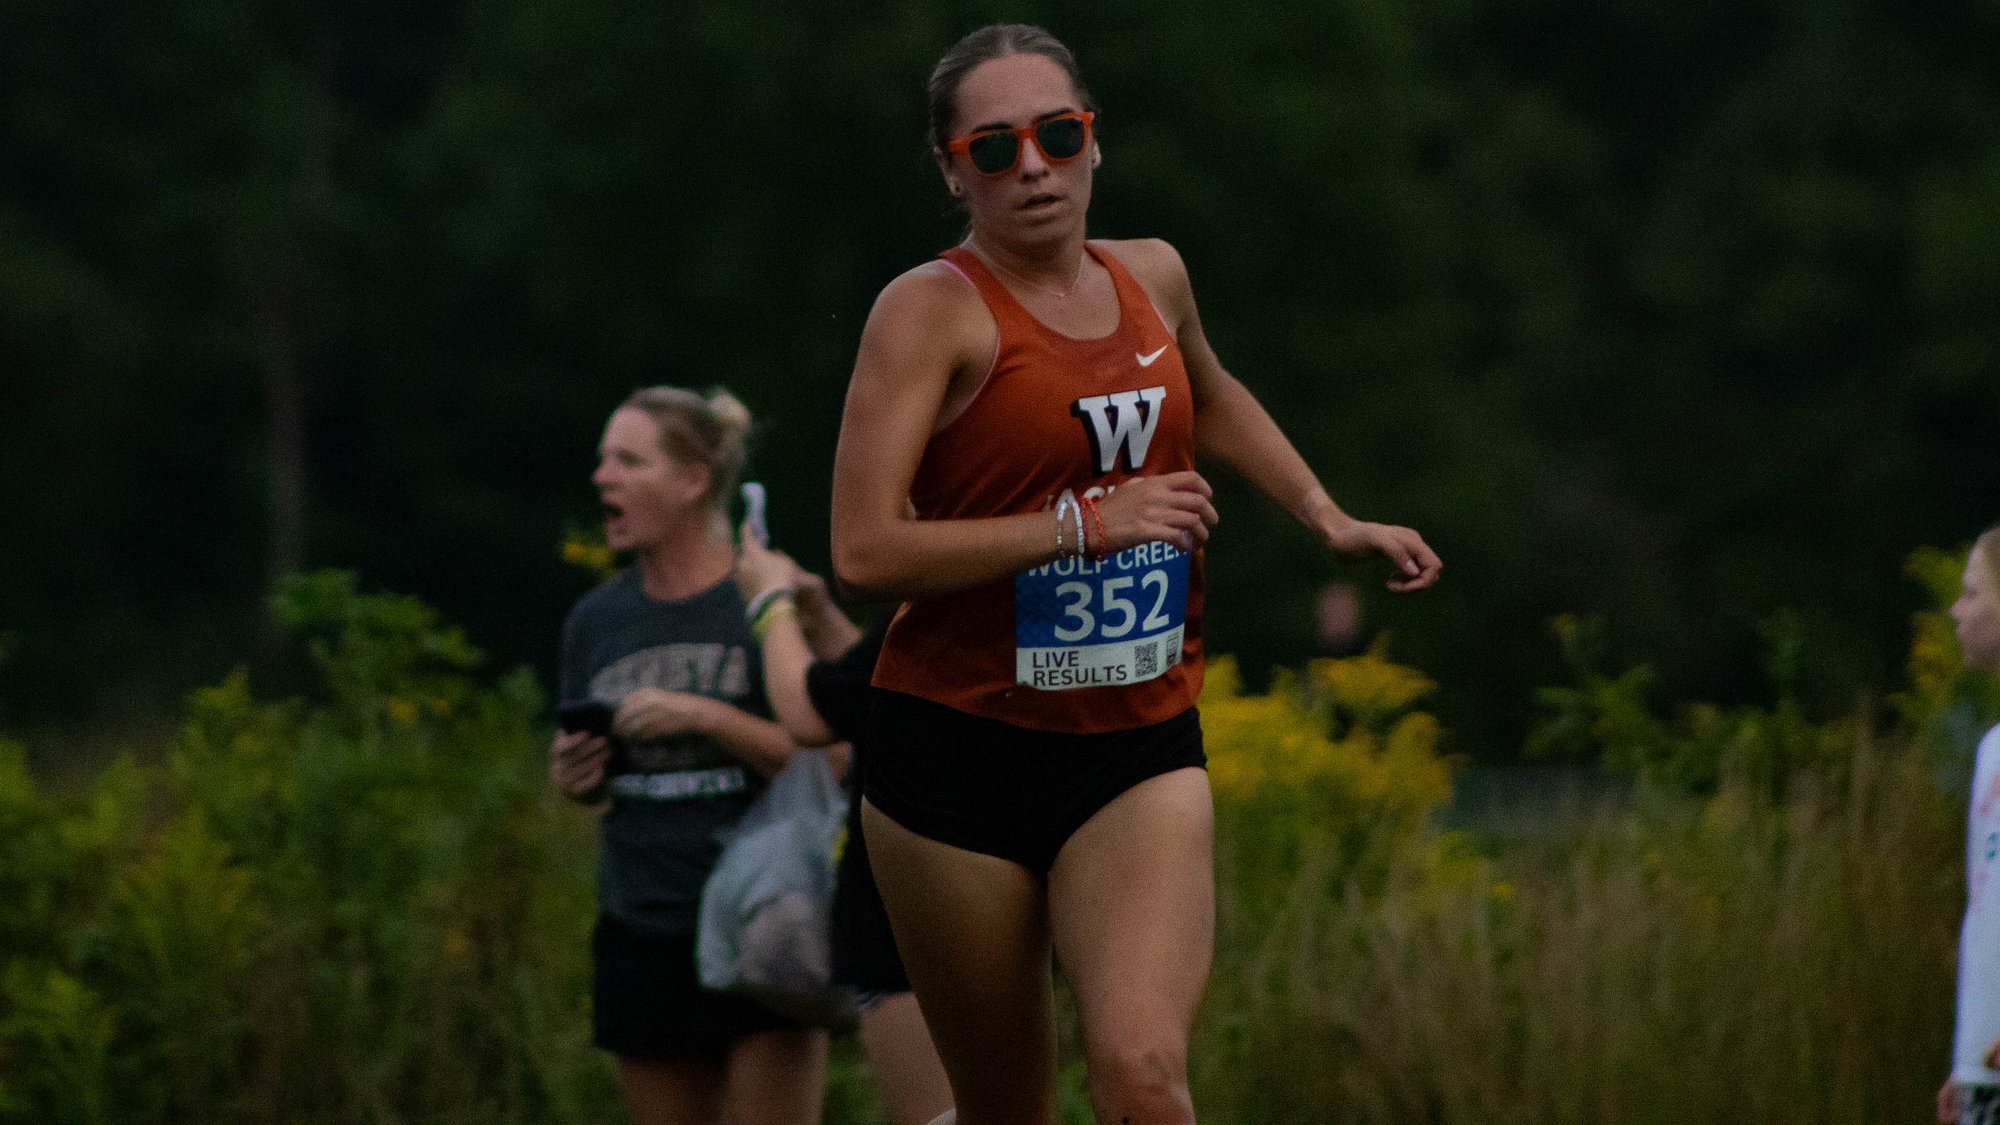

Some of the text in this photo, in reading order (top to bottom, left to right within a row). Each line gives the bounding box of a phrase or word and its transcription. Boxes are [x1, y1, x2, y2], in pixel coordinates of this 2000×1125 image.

[1070, 385, 1167, 475] W
[1117, 541, 1188, 570] CREE
[1054, 569, 1170, 643] 352
[1033, 650, 1080, 668] LIVE
[1033, 664, 1128, 687] RESULTS
